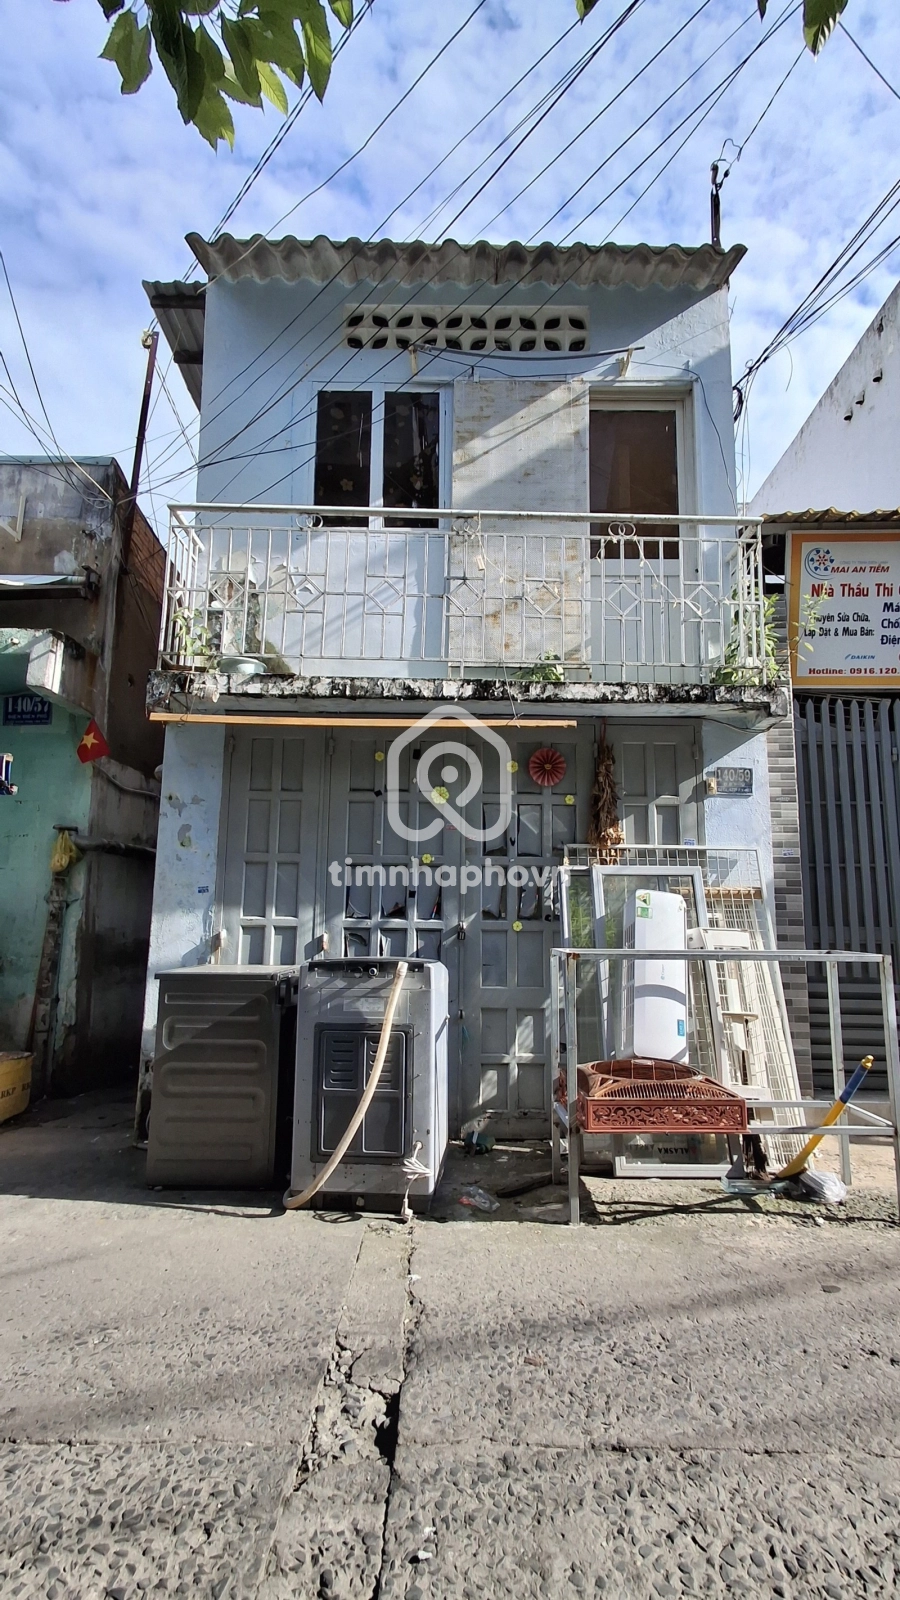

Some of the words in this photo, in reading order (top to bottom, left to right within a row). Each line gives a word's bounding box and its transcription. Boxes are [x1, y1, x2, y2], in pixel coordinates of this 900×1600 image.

[811, 583, 834, 598] Nhà
[875, 583, 893, 597] Thi
[834, 628, 839, 636] &
[842, 627, 857, 636] Mua
[8, 697, 49, 712] 140/57
[717, 769, 751, 782] 140/59
